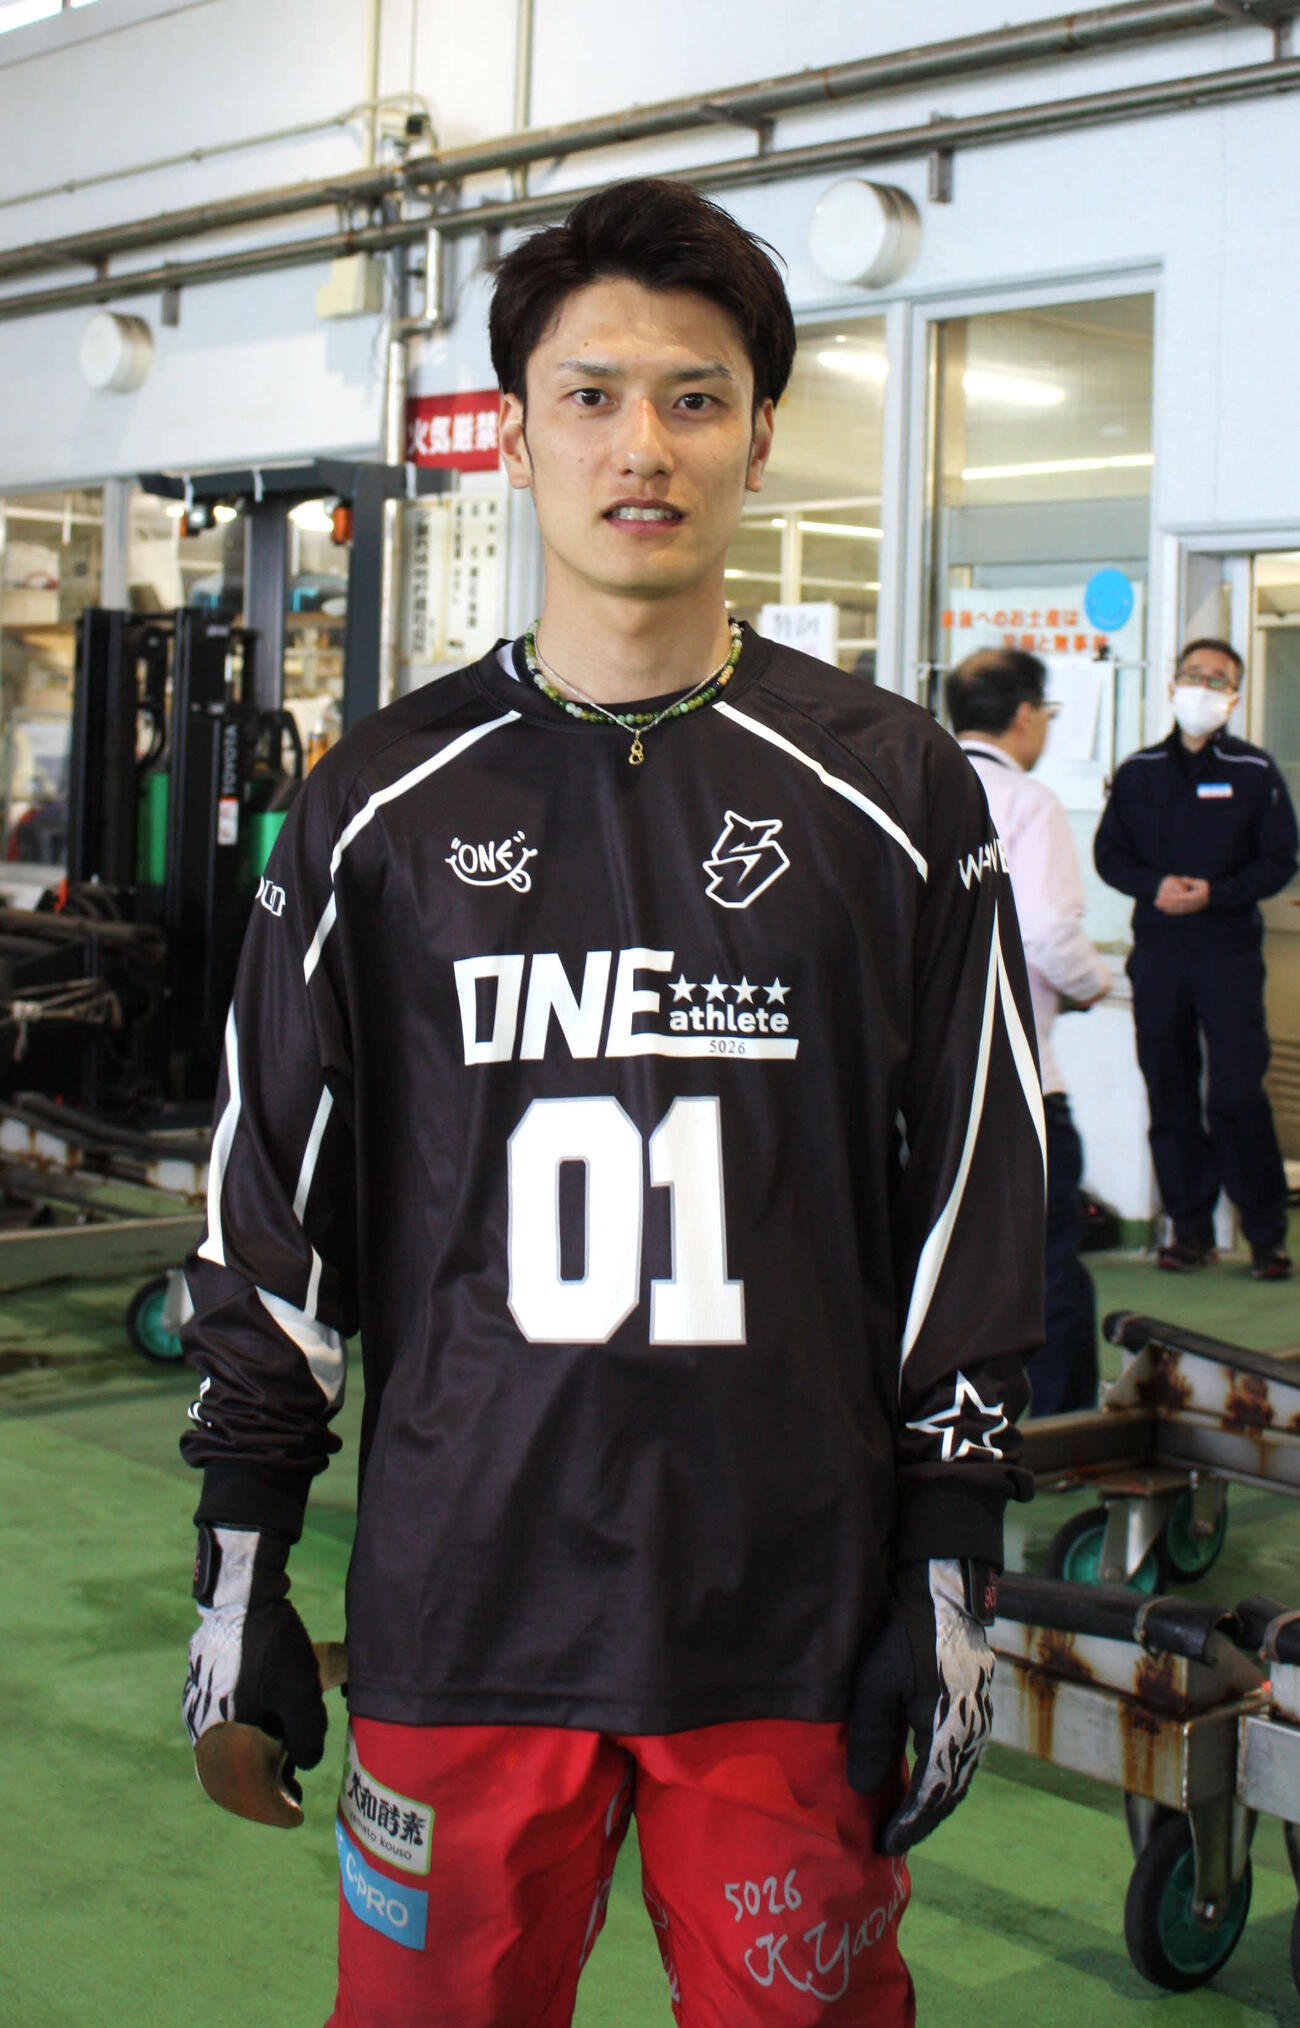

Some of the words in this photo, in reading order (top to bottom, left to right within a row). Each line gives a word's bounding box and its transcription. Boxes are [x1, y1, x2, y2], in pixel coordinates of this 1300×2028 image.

[221, 724, 239, 796] TOYOTA
[453, 947, 676, 1067] ONE
[668, 1003, 790, 1034] athlete
[708, 1039, 746, 1055] 5026
[506, 1095, 747, 1346] 01
[347, 1770, 427, 1846] 大和酵素
[724, 1868, 802, 1922] 5026
